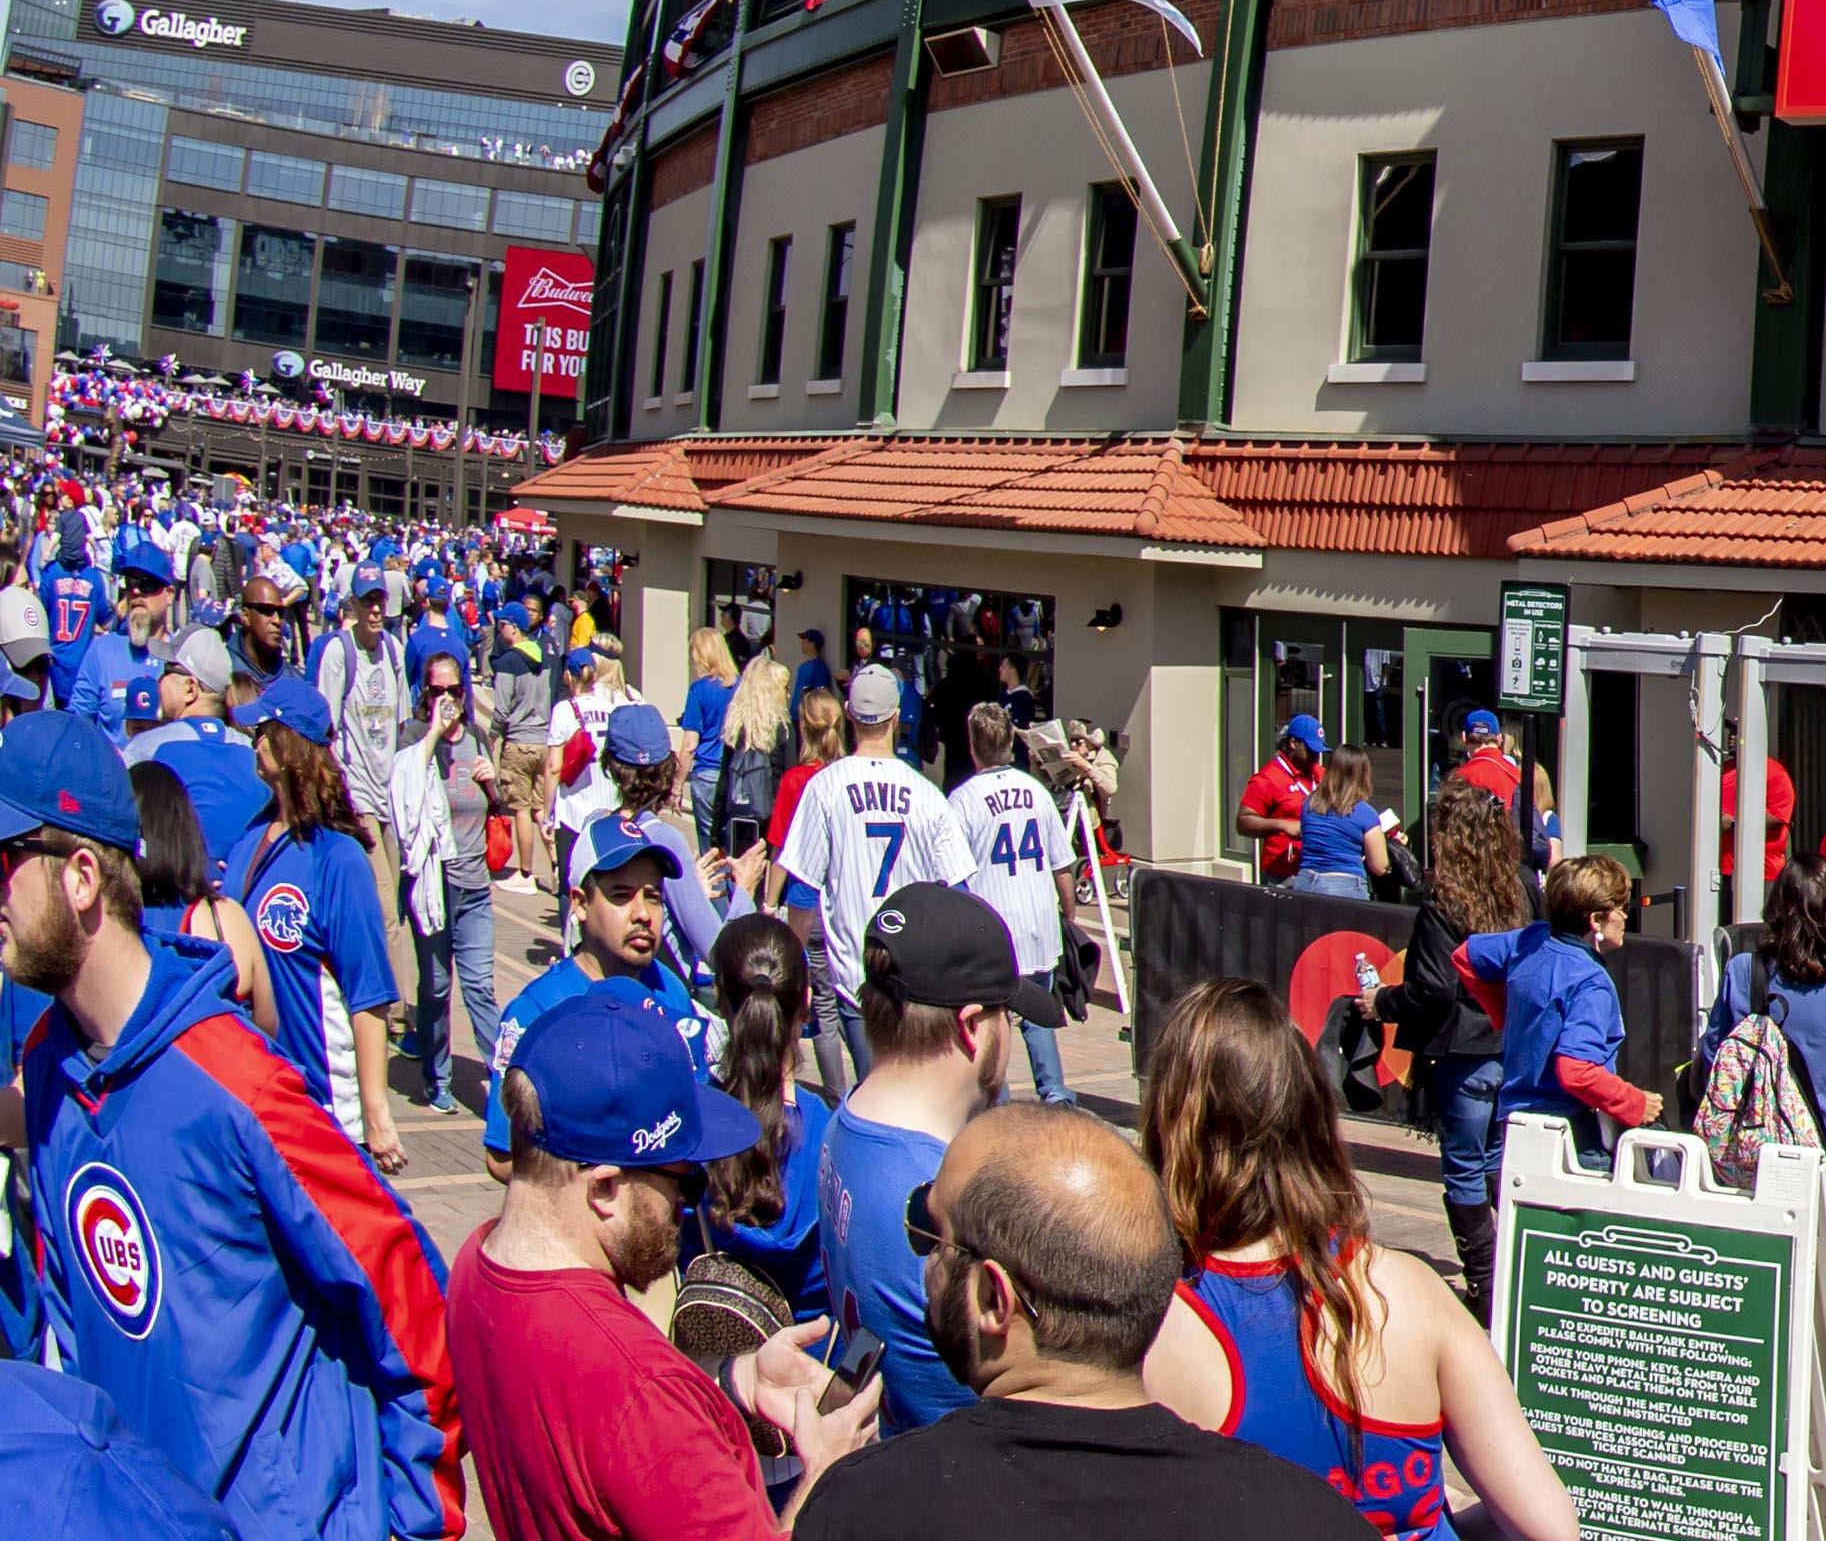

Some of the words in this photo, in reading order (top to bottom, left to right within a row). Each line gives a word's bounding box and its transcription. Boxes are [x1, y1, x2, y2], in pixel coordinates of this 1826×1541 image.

[139, 9, 247, 48] Gallagher
[309, 359, 388, 388] Gallagher
[389, 371, 426, 397] Way
[56, 598, 91, 642] 17
[846, 781, 912, 815] DAVIS
[984, 787, 1034, 817] RIZZO
[865, 821, 906, 898] 7
[991, 818, 1044, 876] 44
[876, 909, 906, 934] C
[633, 1110, 682, 1155] Dodgers
[1544, 1250, 1573, 1267] ALL
[1576, 1255, 1636, 1277] GUESTS
[1639, 1263, 1676, 1282] AND
[1679, 1267, 1749, 1291] GUESTS'
[1546, 1270, 1630, 1296] PROPERTY
[1633, 1282, 1666, 1303] ARE
[1669, 1288, 1744, 1313] SUBJECT
[1581, 1297, 1604, 1314] TO
[1607, 1301, 1702, 1329] SCREENING
[1538, 1326, 1576, 1341] PLEASE
[1578, 1334, 1623, 1349] COMPLY
[1625, 1341, 1654, 1354] WITH
[1656, 1345, 1678, 1357] THE
[1680, 1348, 1752, 1367] FOLLOWING:
[1560, 1319, 1575, 1330] TO
[1576, 1321, 1627, 1339] EXPEDITE
[1628, 1329, 1686, 1348] BALLPARK
[1688, 1339, 1729, 1354] ENTRY,
[1530, 1342, 1573, 1359] REMOVE
[1575, 1350, 1605, 1364] YOUR
[1607, 1355, 1648, 1371] PHONE,
[1651, 1362, 1682, 1376] KEYS,
[1684, 1367, 1732, 1383] CAMERA
[1734, 1375, 1760, 1387] AND
[1536, 1354, 1571, 1368] OTHER
[1573, 1360, 1609, 1374] HEAVY
[1611, 1366, 1647, 1381] METAL
[1649, 1372, 1682, 1386] ITEMS
[1684, 1378, 1717, 1391] FROM
[1719, 1382, 1752, 1396] YOUR
[1531, 1363, 1579, 1380] POCKETS
[1581, 1372, 1604, 1384] AND
[1606, 1376, 1641, 1391] PLACE
[1643, 1382, 1674, 1396] THEM
[1676, 1386, 1694, 1398] ON
[1696, 1390, 1719, 1402] THE
[1720, 1394, 1757, 1408] TABLE
[1538, 1382, 1568, 1396] WALK
[1570, 1387, 1624, 1406] THROUGH
[1625, 1397, 1646, 1409] THE
[1649, 1401, 1685, 1415] METAL
[1688, 1407, 1748, 1425] DETECTOR
[1520, 1406, 1561, 1423] GATHER
[1563, 1413, 1593, 1428] YOUR
[1595, 1419, 1666, 1441] BELONGINGS
[1667, 1432, 1692, 1445] AND
[1694, 1436, 1749, 1453] PROCEED
[1751, 1444, 1768, 1455] TO
[1588, 1401, 1621, 1416] WHEN
[1623, 1407, 1692, 1427] INSTRUCTED
[1530, 1419, 1563, 1433] GUEST
[1565, 1425, 1615, 1443] SERVICES
[1617, 1432, 1679, 1453] ASSOCIATE
[1681, 1445, 1697, 1456] TO
[1699, 1448, 1731, 1462] HAVE
[1733, 1452, 1767, 1467] YOUR
[1592, 1440, 1631, 1456] TICKET
[1632, 1447, 1686, 1465] SCANNED
[1558, 1454, 1574, 1466] DO
[1576, 1458, 1600, 1471] NOT
[1601, 1462, 1631, 1477] HAVE
[1633, 1468, 1641, 1479] A
[1643, 1470, 1670, 1484] BAG,
[1672, 1475, 1714, 1490] PLEASE
[1715, 1481, 1738, 1494] USE
[1740, 1485, 1763, 1498] THE
[1651, 1482, 1686, 1497] LINES.
[1567, 1485, 1586, 1497] ARE
[1587, 1488, 1631, 1505] UNABLE
[1632, 1496, 1649, 1508] TO
[1650, 1499, 1684, 1514] WALK
[1686, 1505, 1743, 1523] THROUGH
[1744, 1514, 1754, 1525] A
[1573, 1496, 1614, 1512] TECTOR
[1616, 1505, 1639, 1516] FOR
[1640, 1510, 1665, 1522] ANY
[1666, 1513, 1716, 1531] REASON,
[1718, 1520, 1761, 1537] PLEASE
[1589, 1509, 1605, 1521] AN
[1607, 1513, 1671, 1534] ALTERNATE
